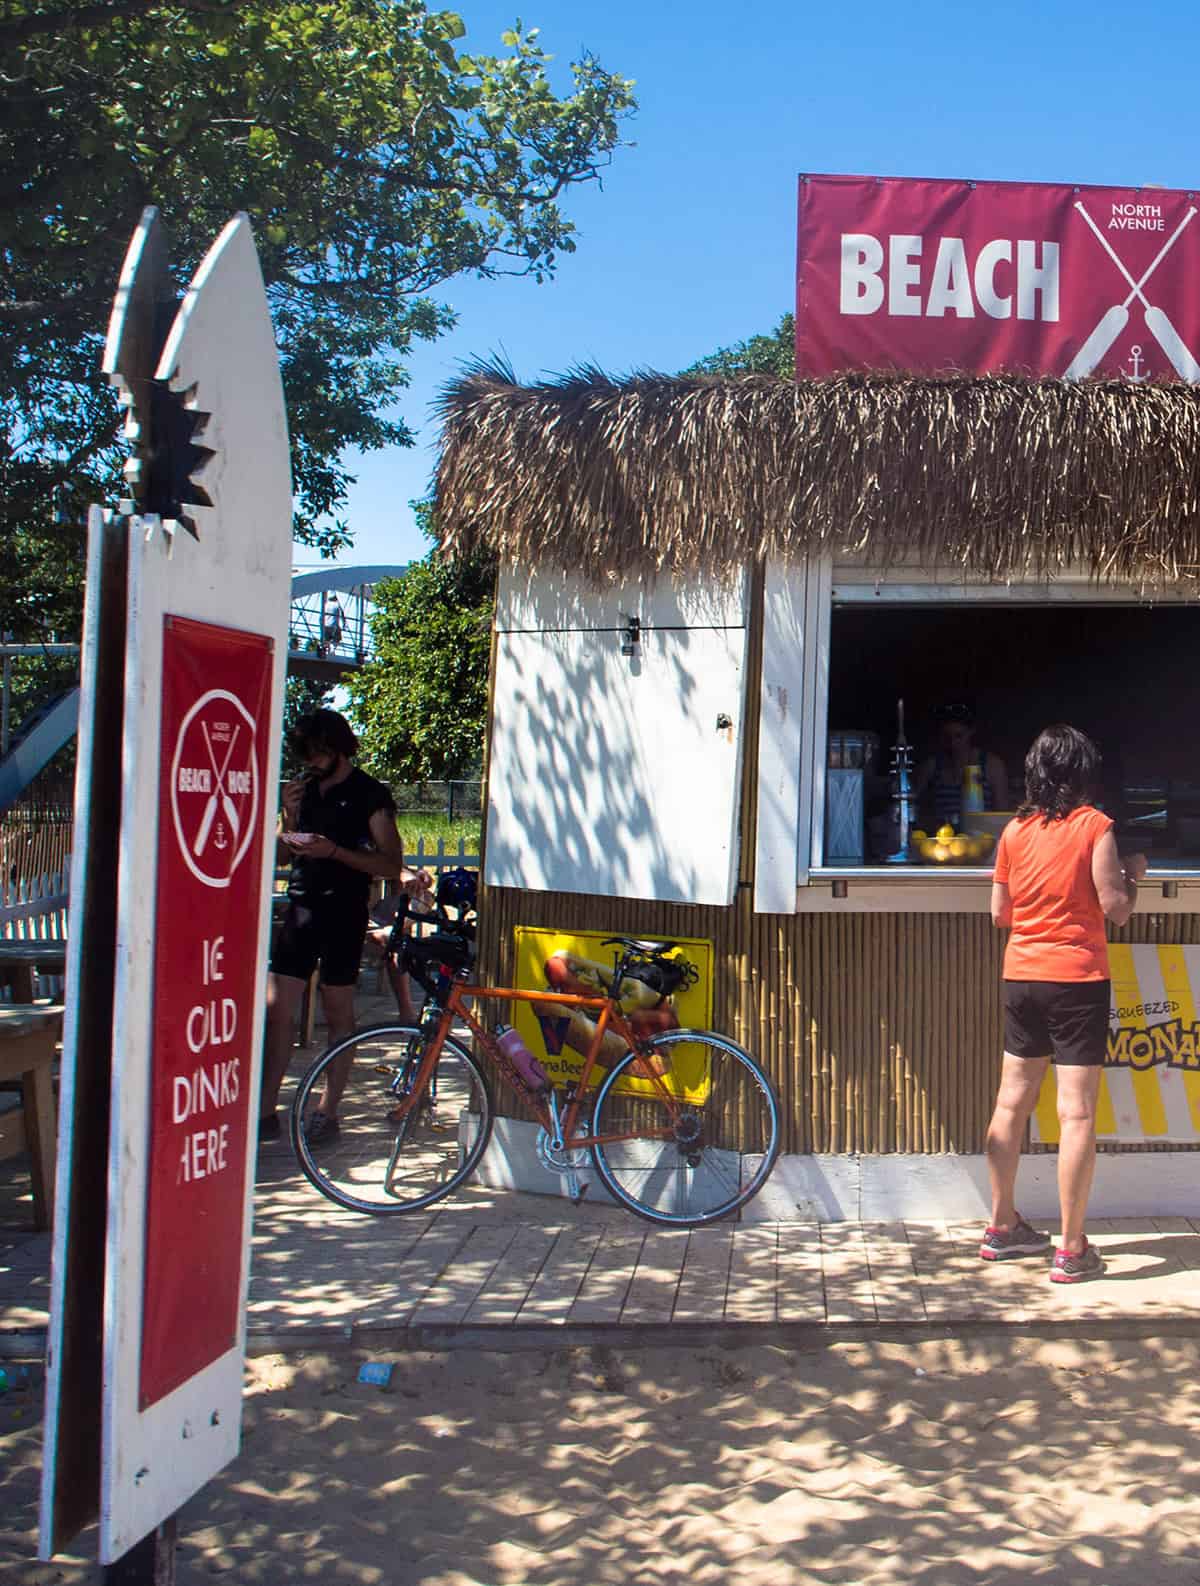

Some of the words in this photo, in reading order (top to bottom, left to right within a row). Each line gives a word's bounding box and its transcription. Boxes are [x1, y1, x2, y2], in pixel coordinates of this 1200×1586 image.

[1111, 203, 1161, 217] NORTH
[1107, 217, 1165, 231] AVENUE
[839, 232, 1060, 323] BEACH
[179, 767, 211, 793] BEACH
[1107, 1000, 1180, 1020] SQUEEZED
